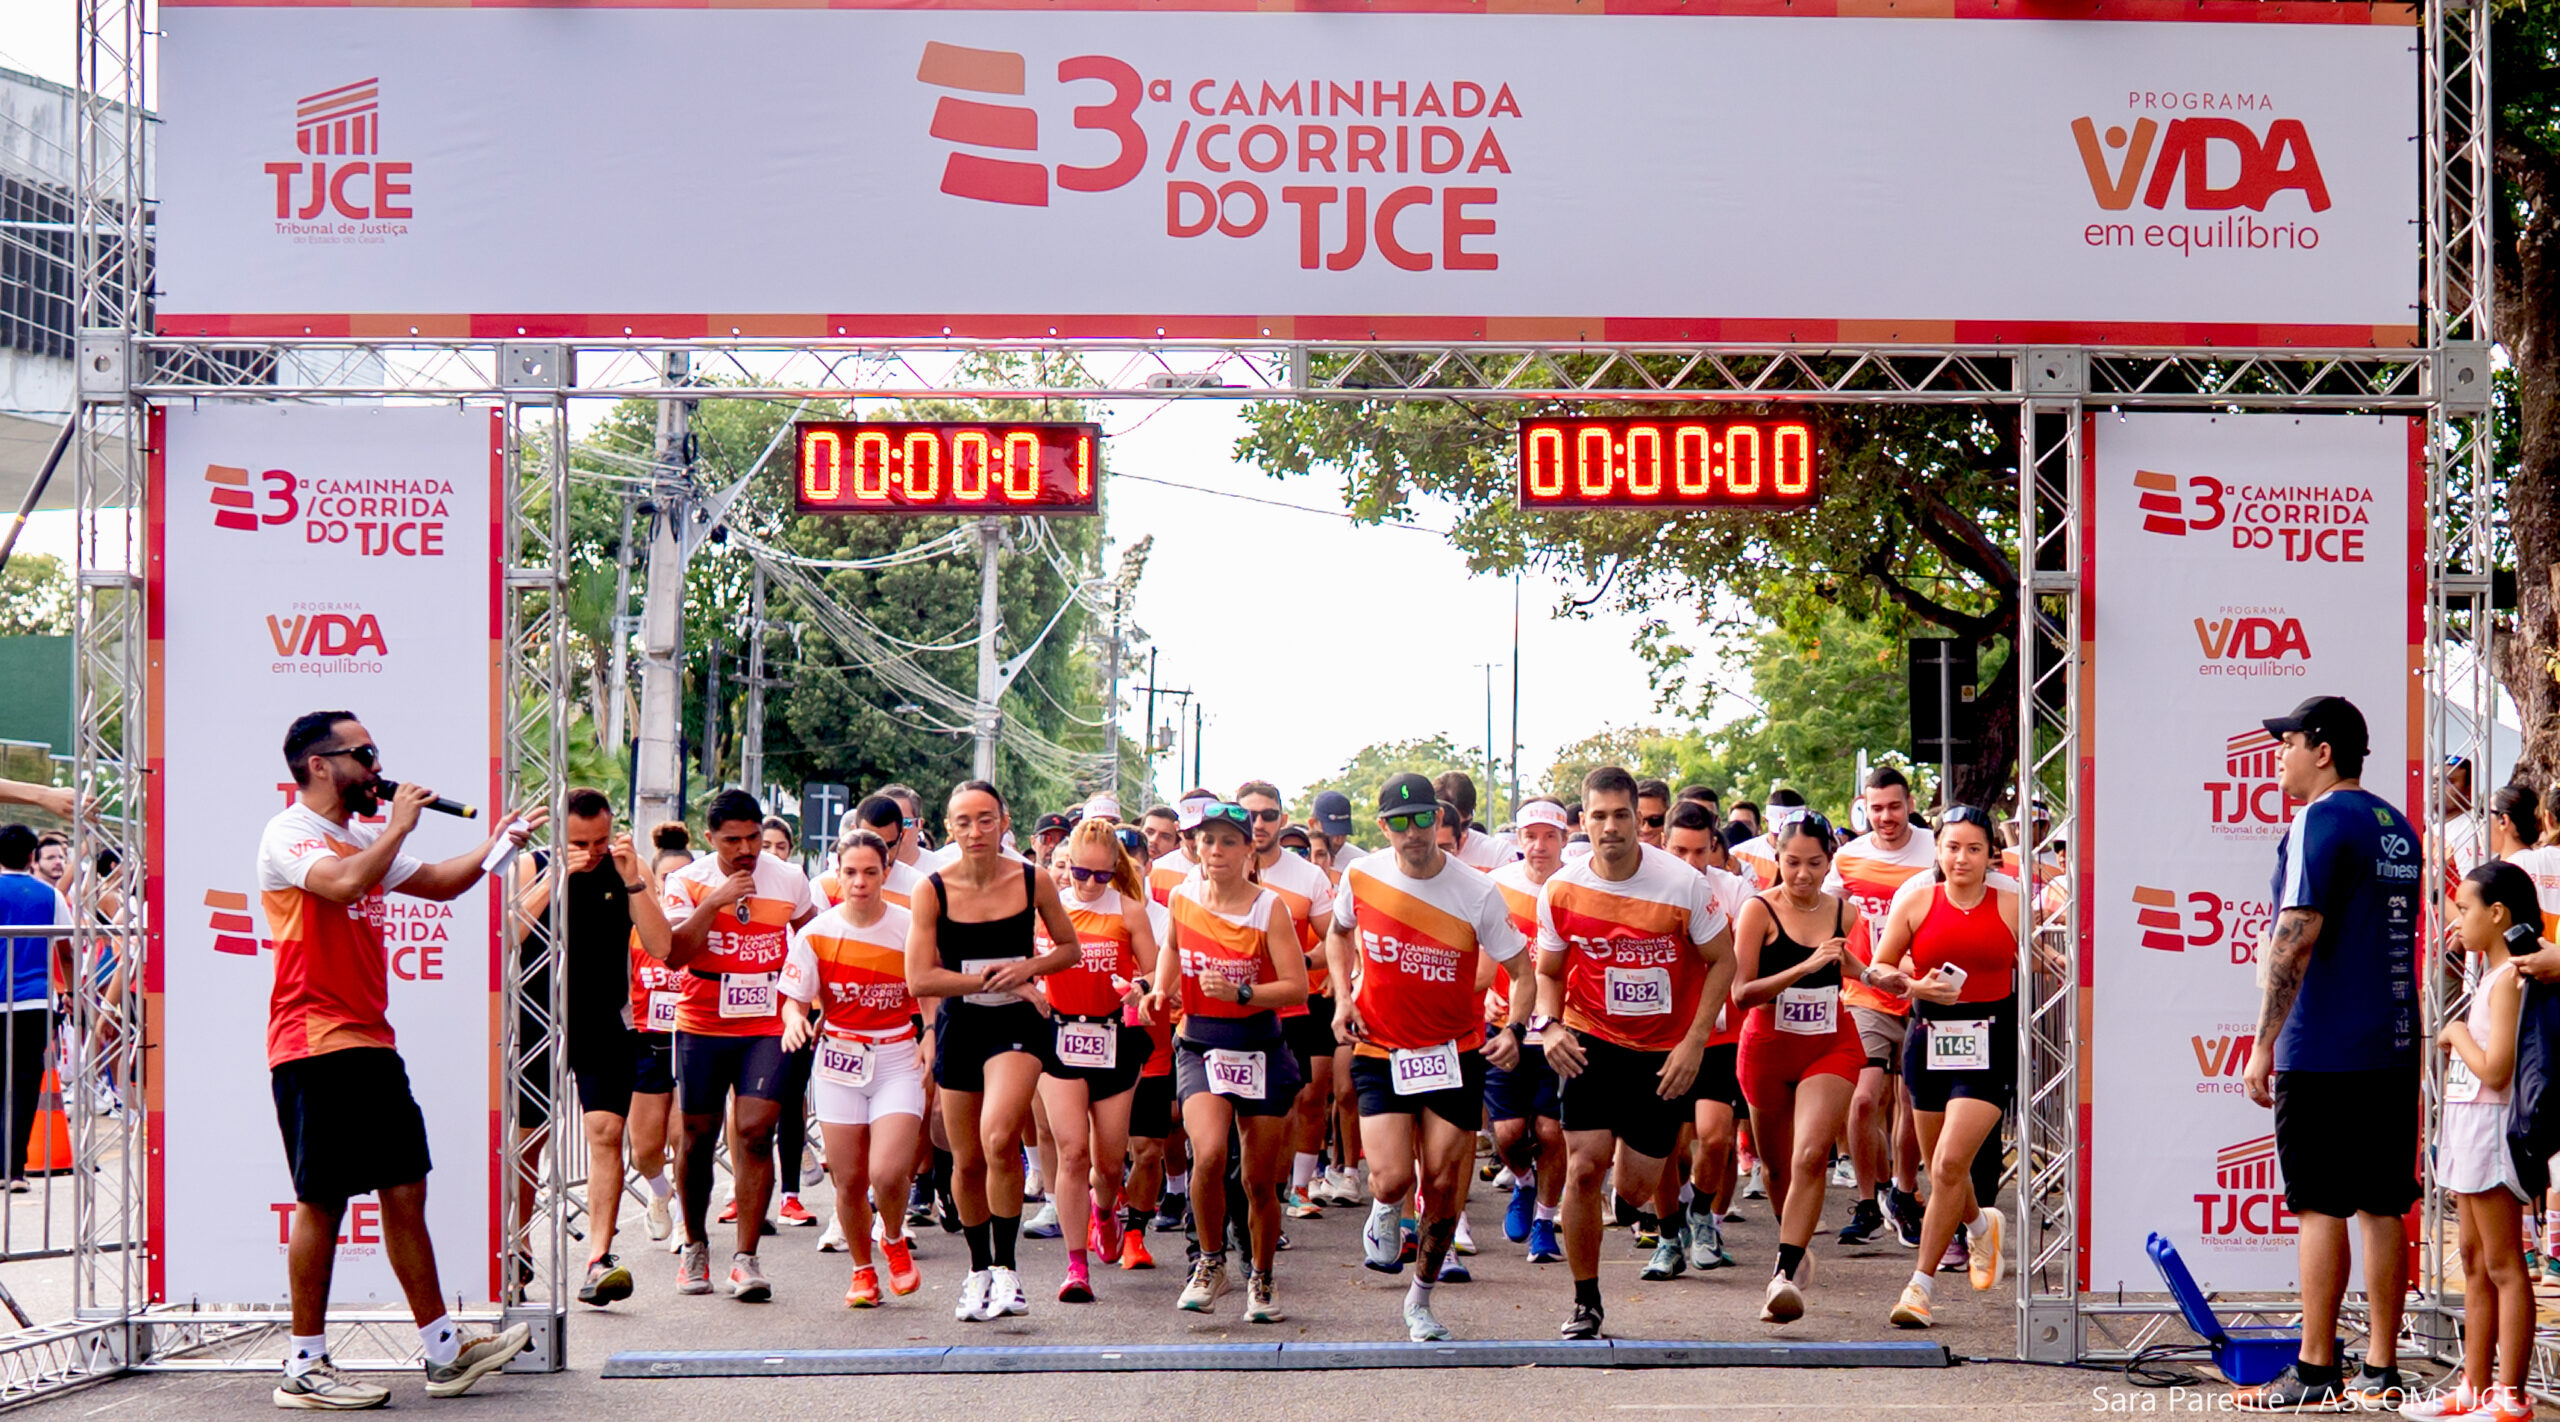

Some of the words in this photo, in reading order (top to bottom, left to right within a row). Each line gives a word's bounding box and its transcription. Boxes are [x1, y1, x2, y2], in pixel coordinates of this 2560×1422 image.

[1189, 79, 1522, 118] CAMINHADA
[2129, 91, 2274, 110] PROGRAMA
[1166, 120, 1512, 174] /CORRIDA
[2071, 116, 2332, 213] VIDA
[264, 162, 413, 220] TJCE
[275, 223, 333, 234] Tribunal
[338, 223, 356, 234] de
[360, 223, 408, 236] Justiça
[1167, 180, 1269, 239] DO
[1282, 186, 1499, 272] TJCE
[2084, 223, 2135, 247] em
[2144, 215, 2320, 258] equilíbrio
[805, 431, 1089, 500] 00:00:01
[1529, 425, 1809, 496] 00:00:00
[316, 479, 454, 495] CAMINHADA
[2241, 486, 2374, 503] CAMINHADA
[306, 496, 450, 518] /CORRIDA
[2232, 502, 2370, 525] /CORRIDA
[306, 520, 349, 543] DO
[355, 522, 444, 556] TJCE
[2233, 526, 2274, 549] DO
[2279, 528, 2364, 562] TJCE
[293, 602, 361, 611] PROGRAMA
[2219, 606, 2286, 615] PROGRAMA
[266, 614, 388, 657] VIDA
[2194, 617, 2312, 660] VIDA
[272, 661, 296, 673] em
[300, 657, 383, 678] equilíbrio
[2199, 664, 2223, 676] em
[2226, 661, 2306, 680] equilíbrio
[2211, 825, 2253, 834] Tribunal
[2255, 825, 2268, 834] de
[1404, 942, 1461, 958] CAMINHADA
[384, 945, 443, 981] CE
[1087, 957, 1117, 972] TJCE
[1400, 960, 1420, 974] DO
[1421, 964, 1456, 982] TJCE
[730, 987, 766, 1004] 1968
[1616, 983, 1657, 1001] 1982
[1785, 1002, 1826, 1020] 2115
[2217, 1024, 2257, 1032] PROGR
[1067, 1036, 1103, 1053] 1943
[1936, 1037, 1976, 1055] 1145
[826, 1051, 862, 1073] 1972
[1402, 1055, 1446, 1078] 1986
[1215, 1063, 1251, 1084] 1973
[2196, 1083, 2219, 1093] em
[2193, 1193, 2299, 1235] TJCE
[341, 1246, 377, 1256] Justiça
[2201, 1236, 2242, 1245] Tribunal
[2246, 1236, 2258, 1245] de
[2261, 1236, 2296, 1246] Justiça
